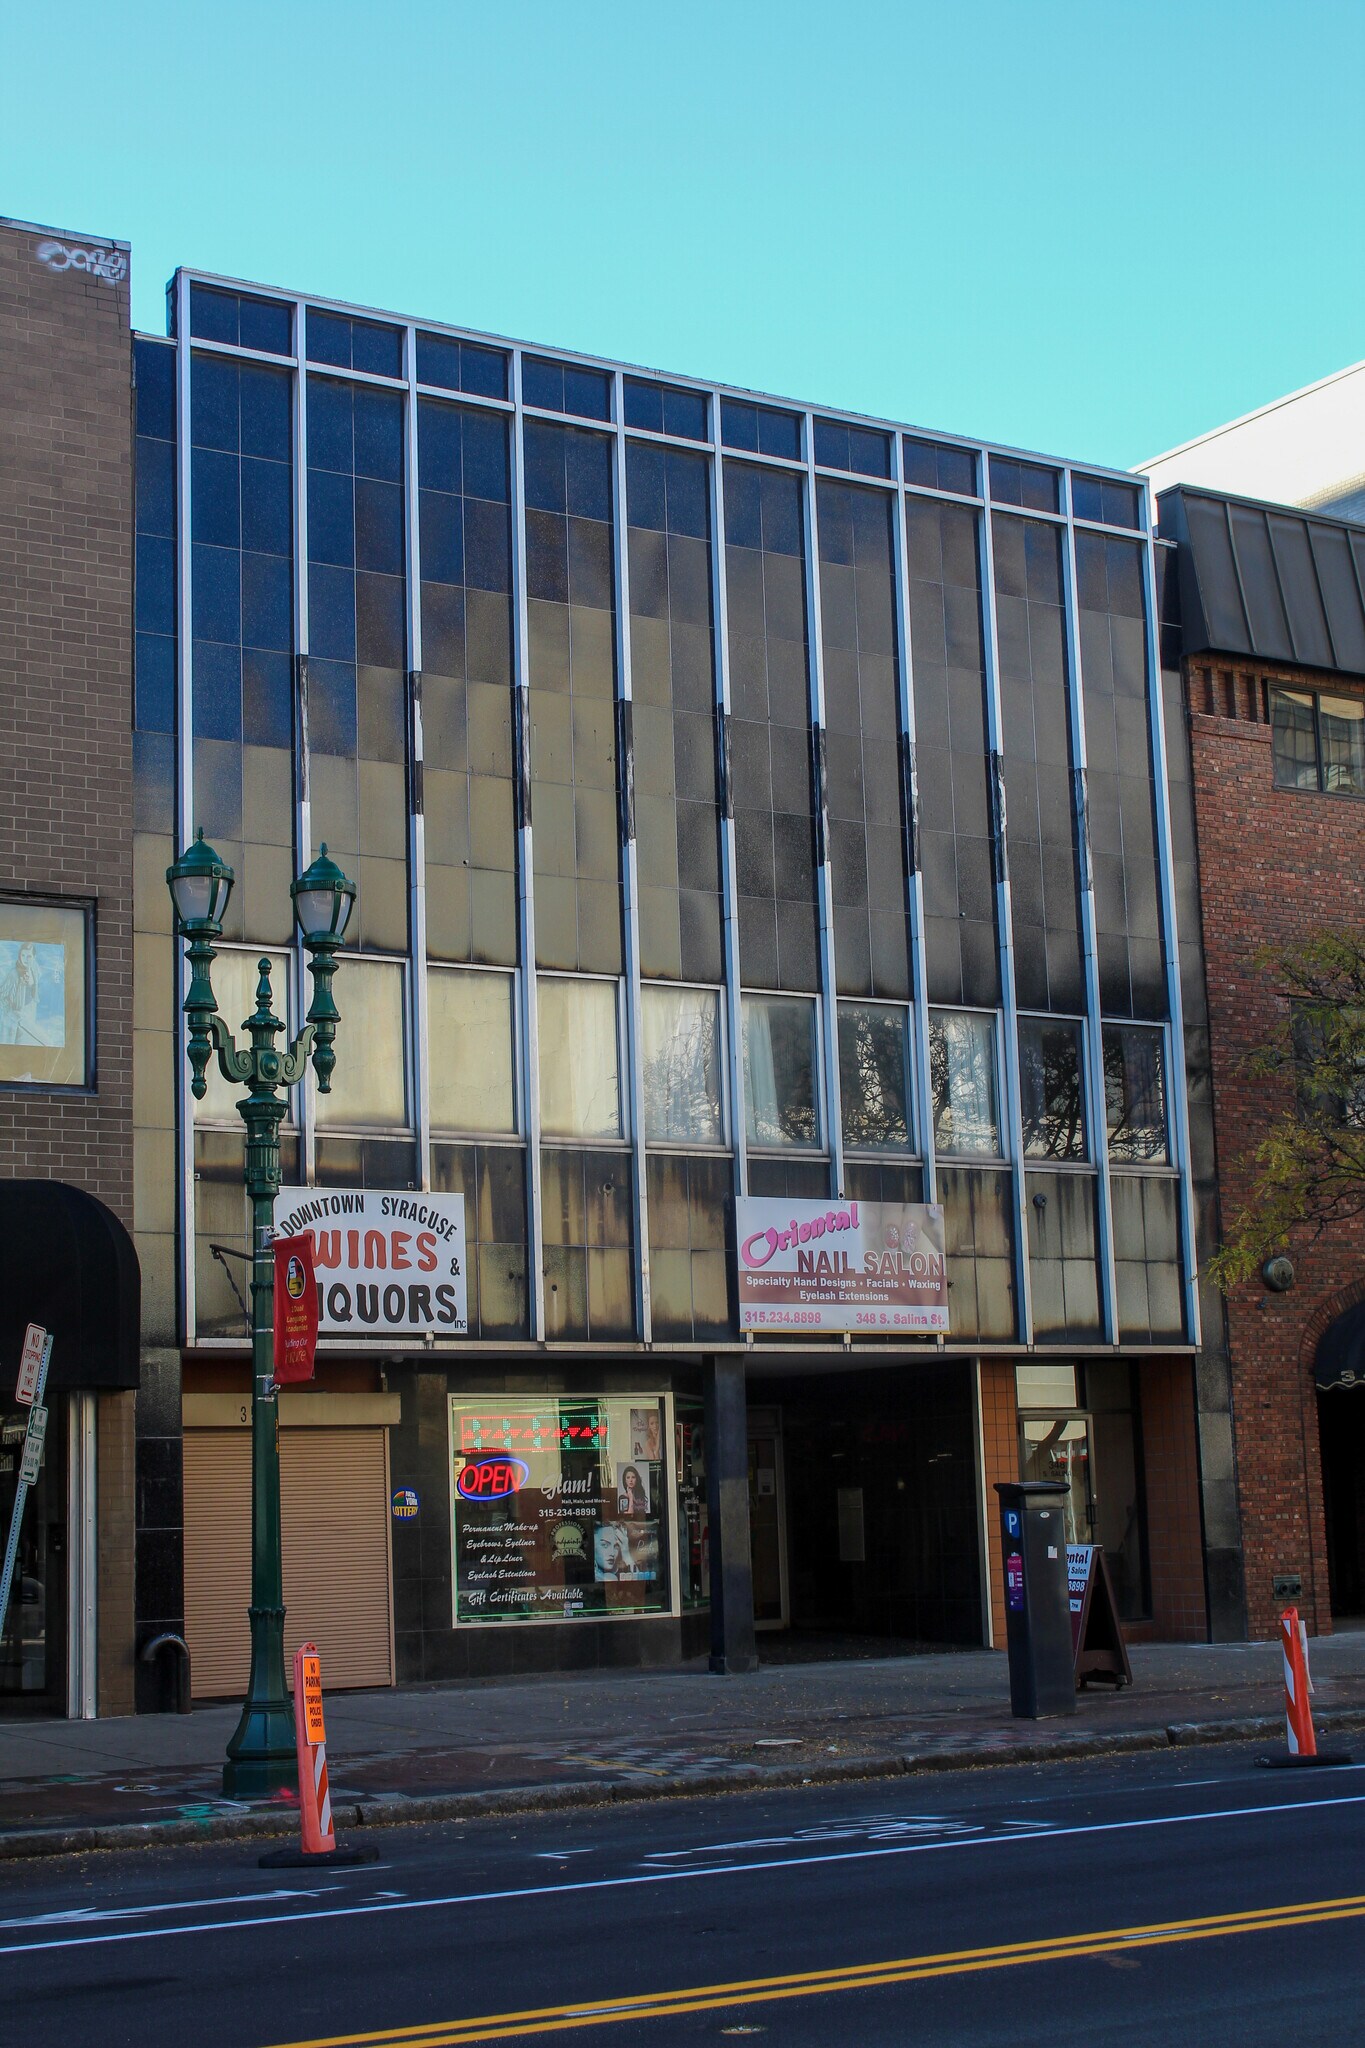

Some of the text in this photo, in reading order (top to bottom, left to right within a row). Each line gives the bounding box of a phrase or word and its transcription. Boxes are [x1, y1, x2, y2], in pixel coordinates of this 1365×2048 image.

[279, 1194, 458, 1242] DOWNTOWN SYRACUSE
[741, 1201, 860, 1269] Oriental
[303, 1229, 438, 1272] WINES
[450, 1257, 460, 1276] &
[797, 1250, 946, 1276] NAIL SALON
[746, 1276, 941, 1291] Specialty Hand Designs Facials Waxing
[800, 1290, 889, 1301] Eyelash Extensions
[316, 1283, 458, 1324] IQUORS
[745, 1311, 821, 1324] 315.234.8898
[856, 1312, 945, 1325] 348 S. Salina St.
[31, 1333, 40, 1348] NO
[25, 1349, 41, 1362] STOPPING
[1048, 1460, 1065, 1469] 348
[460, 1465, 522, 1493] OPEN
[541, 1471, 592, 1500] Glam!
[392, 1506, 419, 1517] LOTTERY
[538, 1508, 597, 1517] 315-234-8898
[462, 1522, 539, 1533] Permanent Make-up
[550, 1520, 586, 1536] PROFESSIONAL
[1008, 1513, 1018, 1533] P
[505, 1538, 536, 1549] Eyeliner
[480, 1553, 524, 1564] & Lip Liner
[1067, 1550, 1089, 1564] ental
[468, 1570, 497, 1581] Eyelash
[1071, 1567, 1087, 1575] Salon
[468, 1588, 584, 1606] Gift Certificates Available
[310, 1662, 316, 1673] NO
